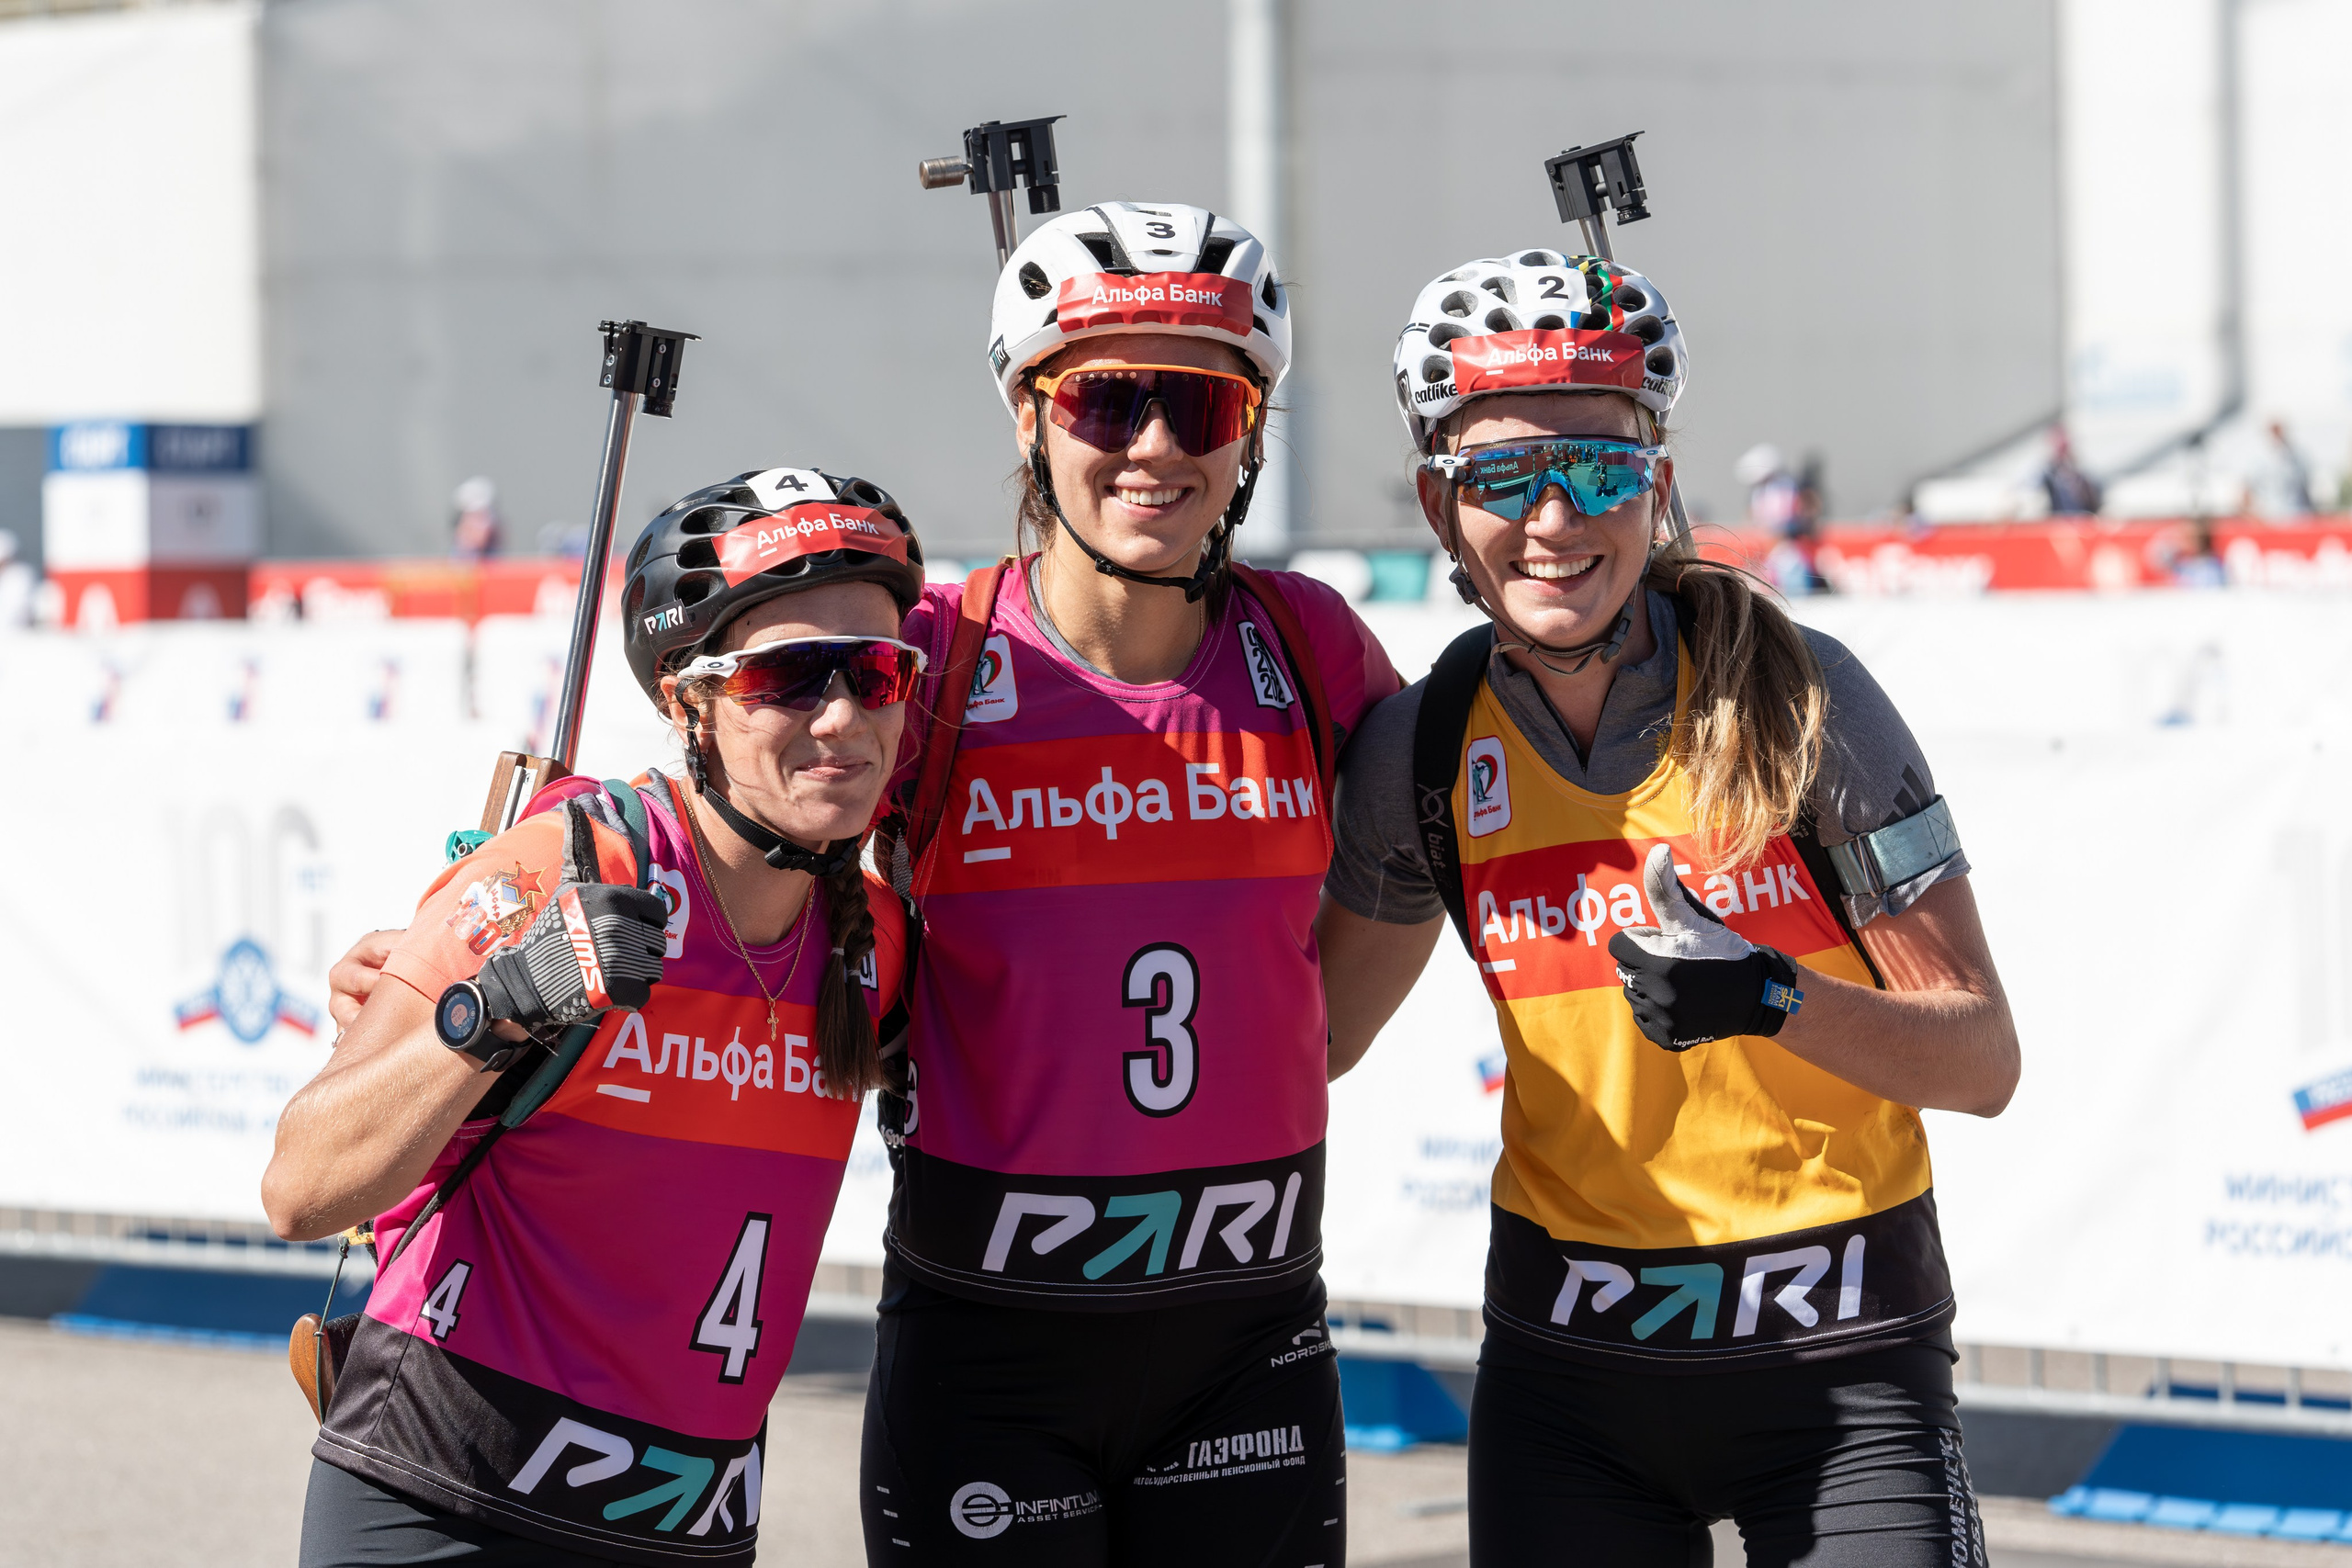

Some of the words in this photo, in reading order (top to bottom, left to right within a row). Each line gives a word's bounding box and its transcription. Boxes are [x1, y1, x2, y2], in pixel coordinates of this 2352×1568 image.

[1145, 221, 1176, 239] 3
[1091, 285, 1165, 306] Альфа
[1170, 284, 1223, 307] Банк
[1537, 276, 1569, 299] 2
[1487, 344, 1558, 367] Альфа
[1562, 341, 1614, 364] Банк
[1415, 382, 1459, 404] catlike
[775, 474, 808, 492] 4
[756, 517, 829, 549] Альфа
[830, 513, 879, 536] Банк
[961, 766, 1173, 840] Альфа
[1185, 762, 1317, 819] Банк
[1476, 874, 1645, 946] Альфа
[1674, 863, 1811, 919] анк
[1125, 945, 1197, 1113] 3
[1673, 1036, 1700, 1047] Legend
[603, 1011, 774, 1100] Альфа
[981, 1171, 1303, 1280] PARI
[420, 1260, 472, 1340] 4
[693, 1214, 770, 1381] 4
[1549, 1234, 1867, 1341] PARI
[1271, 1340, 1332, 1368] NORDSK
[1187, 1425, 1305, 1469] ГАЗФОНД
[1222, 1459, 1281, 1477] ПЕНСИОННЫЙ
[1283, 1456, 1306, 1467] ФОНД
[1015, 1490, 1101, 1515] INFINITUM
[1017, 1513, 1058, 1523] ASSET
